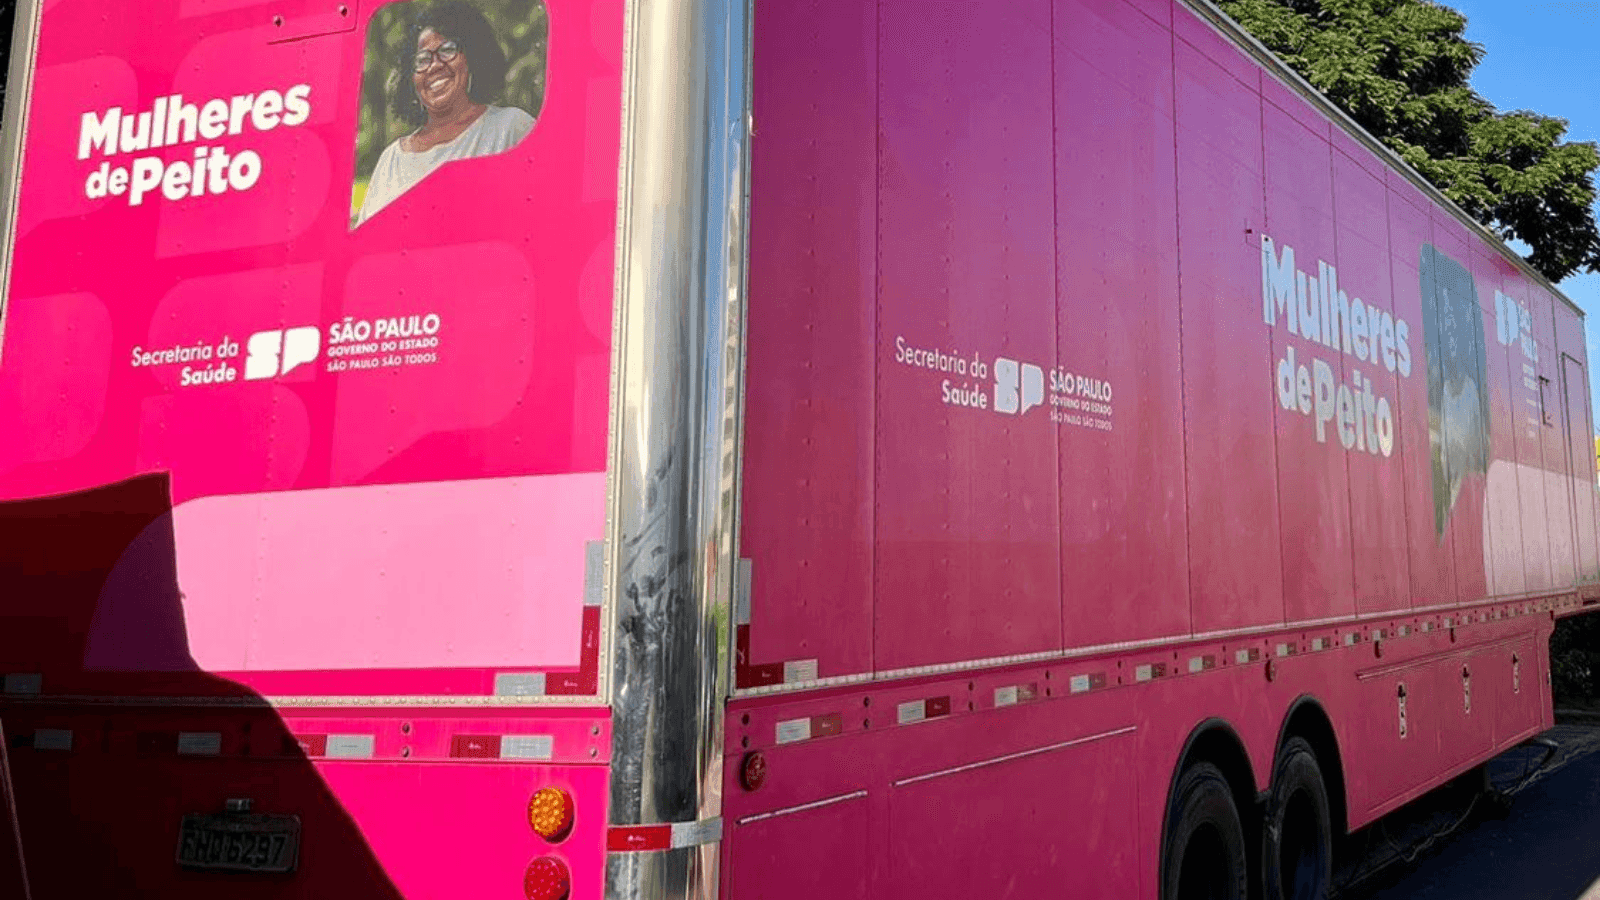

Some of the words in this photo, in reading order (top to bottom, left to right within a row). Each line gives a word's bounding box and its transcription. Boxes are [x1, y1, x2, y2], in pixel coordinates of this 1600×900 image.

[77, 83, 311, 160] Mulheres
[84, 161, 129, 199] de
[129, 146, 262, 206] Peito
[1261, 233, 1411, 378] Mulheres
[329, 316, 371, 344] SÃO
[374, 313, 441, 340] PAULO
[131, 341, 212, 367] Secretaria
[218, 335, 239, 358] da
[327, 342, 378, 357] GOVERNO
[380, 341, 398, 353] DO
[399, 337, 440, 350] ESTADO
[327, 358, 347, 373] SÃO
[349, 356, 379, 370] PAULO
[381, 353, 402, 367] SÃO
[403, 352, 438, 365] TODOS
[896, 336, 966, 374] Secretaria
[969, 351, 987, 379] da
[180, 361, 237, 387] Saúde
[1049, 366, 1075, 394] SÃO
[1076, 375, 1112, 403] PAULO
[942, 379, 988, 409] Saúde
[1277, 345, 1312, 415] de
[1313, 357, 1394, 458] Peito
